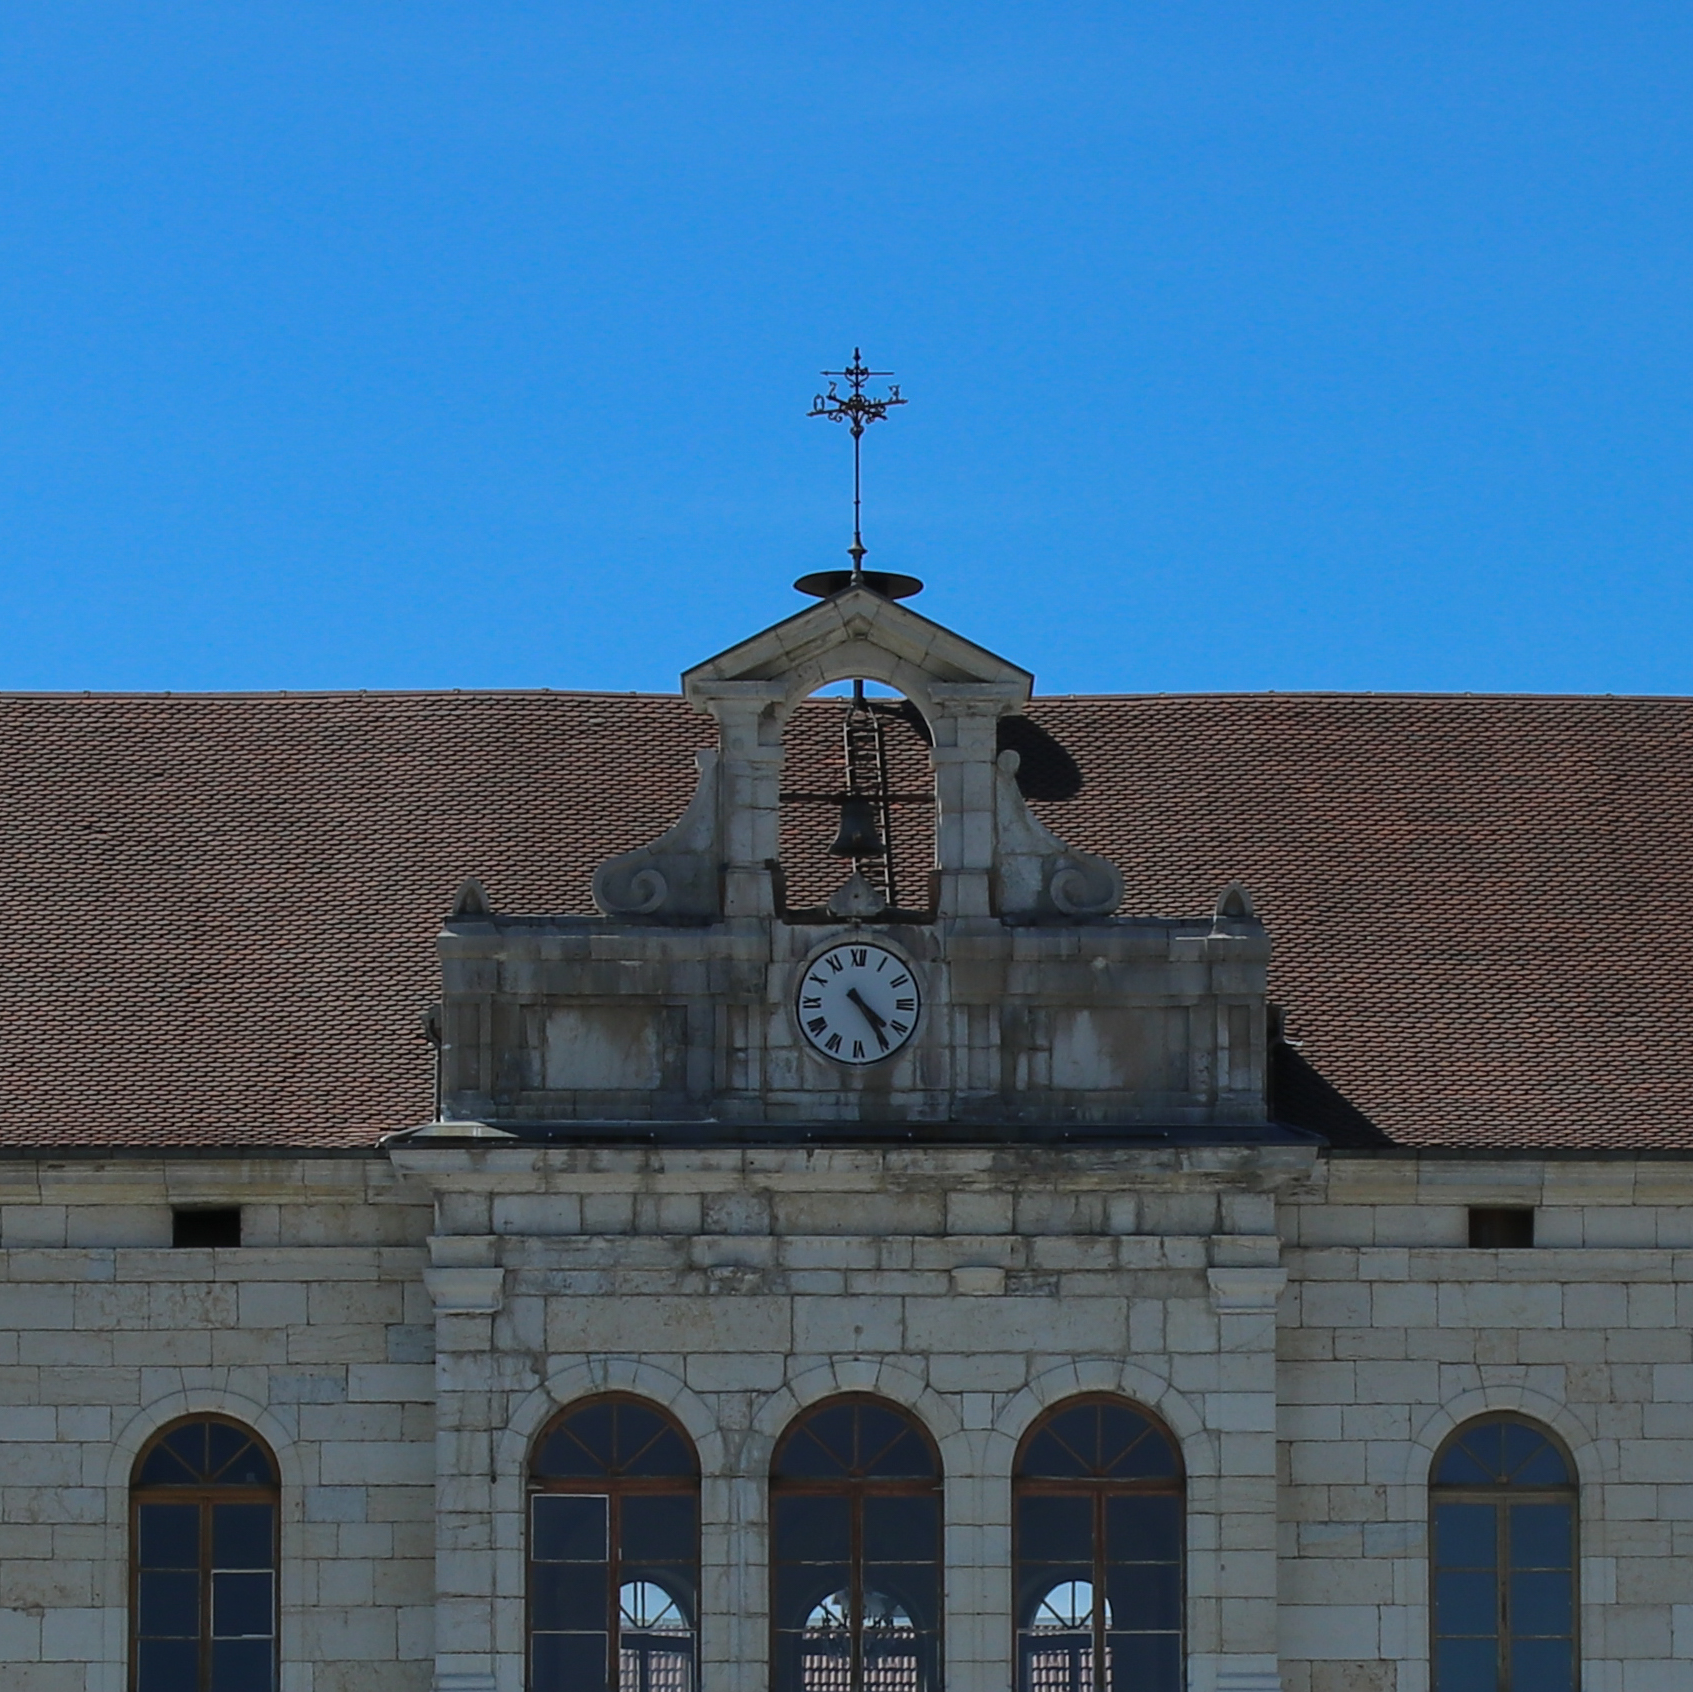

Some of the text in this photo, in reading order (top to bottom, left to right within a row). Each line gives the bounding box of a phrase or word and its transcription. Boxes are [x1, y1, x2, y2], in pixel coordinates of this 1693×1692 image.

[825, 953, 844, 975] XI
[850, 948, 867, 967] XII
[809, 972, 828, 988] X
[890, 973, 909, 989] II
[802, 996, 821, 1009] IX
[895, 998, 914, 1011] III
